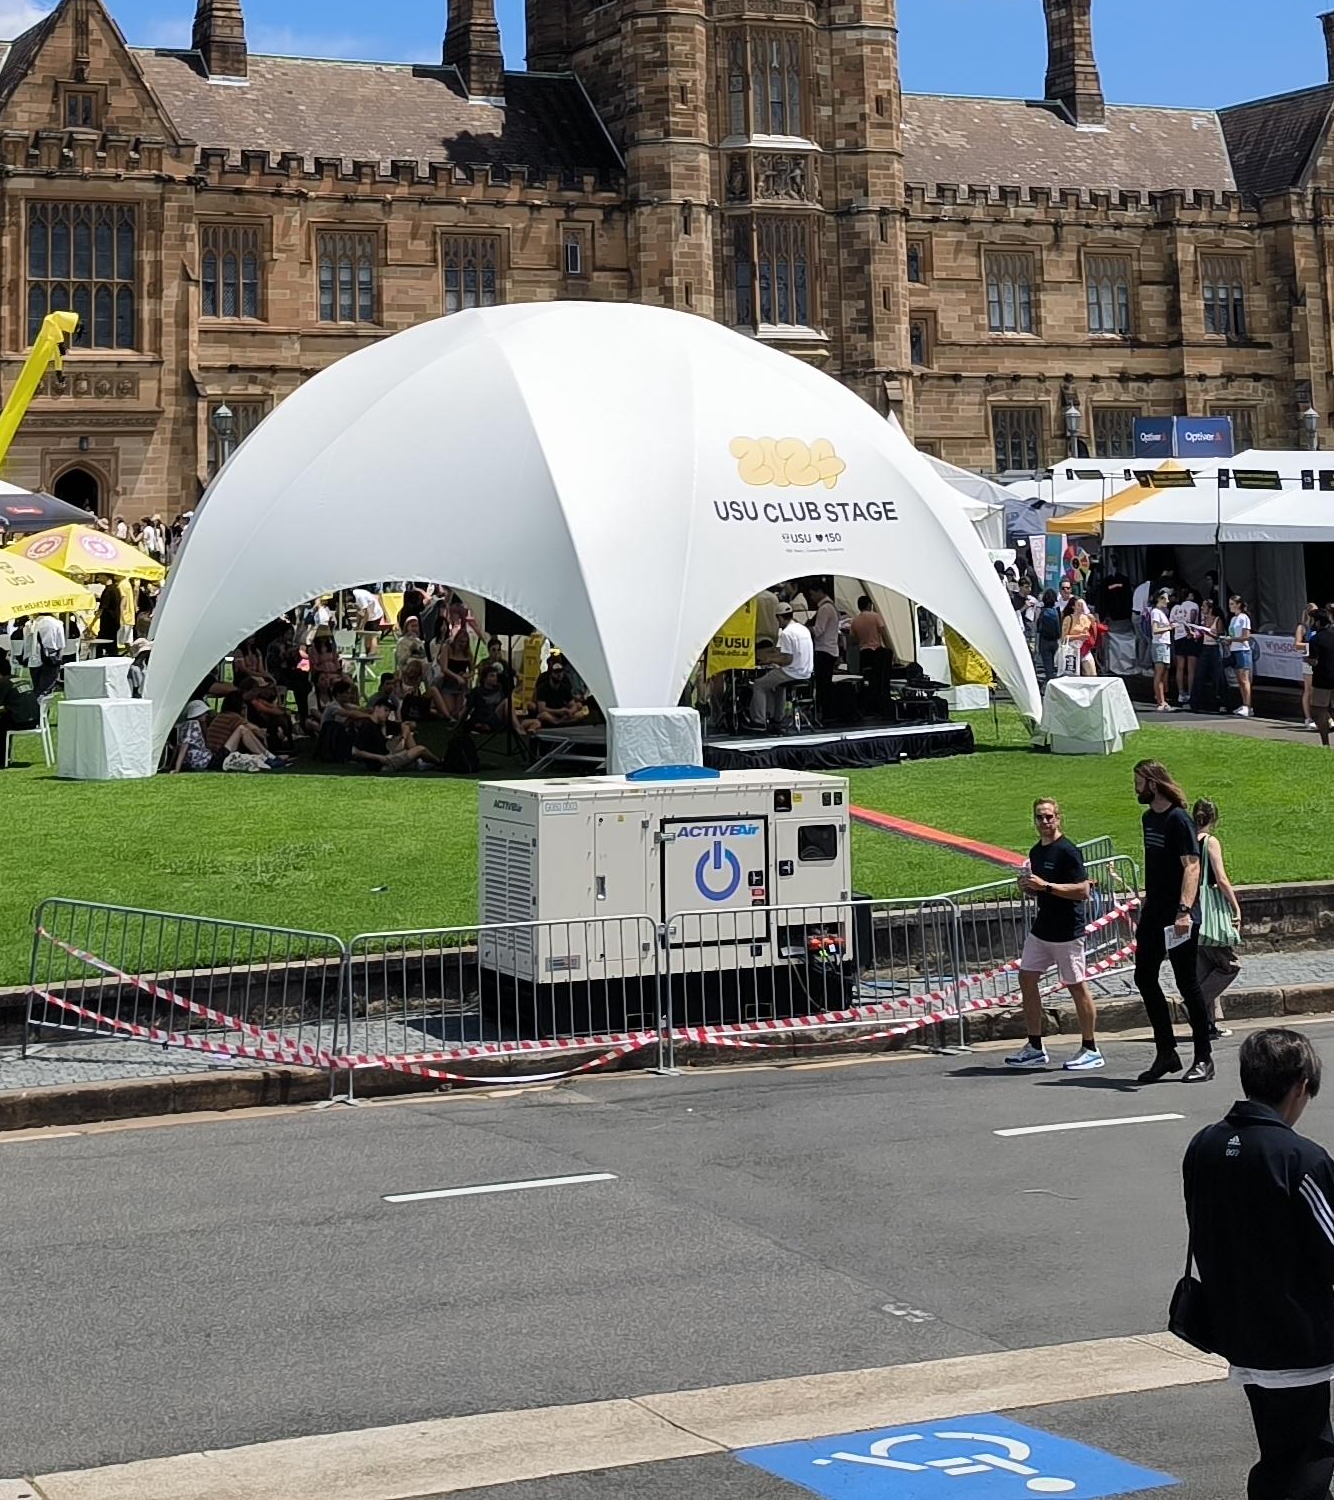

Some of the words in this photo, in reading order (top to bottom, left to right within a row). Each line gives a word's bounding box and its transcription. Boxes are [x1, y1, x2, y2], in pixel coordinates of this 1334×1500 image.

[1185, 432, 1214, 443] Optiver
[714, 500, 759, 521] USU
[763, 501, 821, 523] CLUB
[824, 501, 899, 522] STAGE
[791, 533, 811, 543] USU
[824, 532, 842, 543] 150
[6, 575, 36, 586] USU
[724, 637, 750, 649] USU
